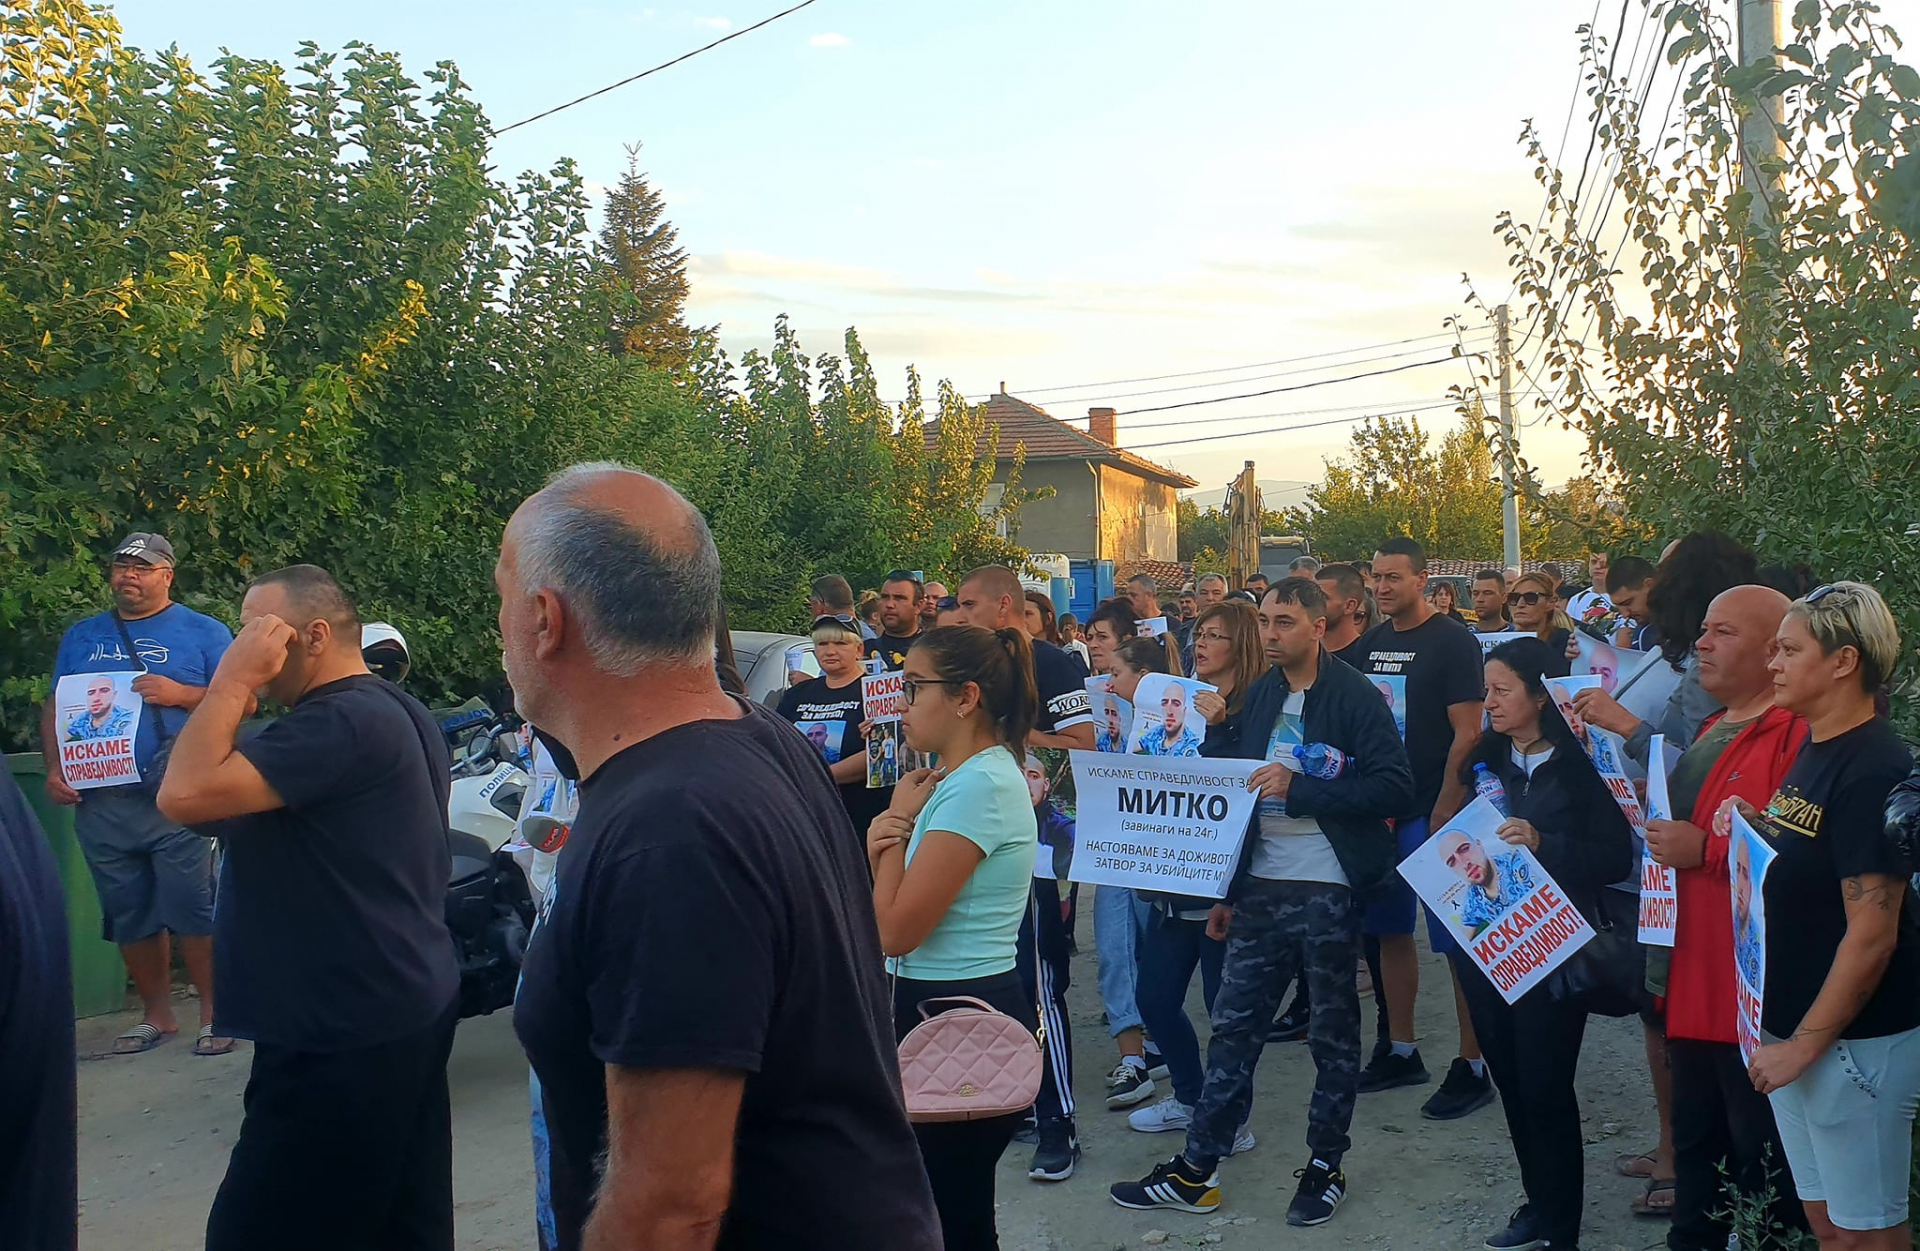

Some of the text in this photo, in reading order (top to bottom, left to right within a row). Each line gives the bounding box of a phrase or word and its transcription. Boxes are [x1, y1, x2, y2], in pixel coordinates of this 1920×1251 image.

[866, 677, 905, 697] ИСКА
[64, 738, 131, 761] ИСКАМЕ
[1088, 767, 1134, 780] ИСКАМЕ
[1137, 770, 1235, 787] СПРАВЕДЛИВОСТ
[1118, 787, 1229, 822] МИТКО
[1121, 819, 1219, 841] (завинаги на 24г.)
[1086, 840, 1234, 867] НАСТОЯВАМЕ ЗА ДОЖИВОТ
[1094, 857, 1136, 872] ЗАТВОР
[1138, 862, 1152, 874] ЗА
[1154, 862, 1212, 881] УБИЙЦИТЕ
[1473, 884, 1561, 966] ИСКАМЕ
[1490, 904, 1584, 992] СПРАВЕДЛИВОСТ!
